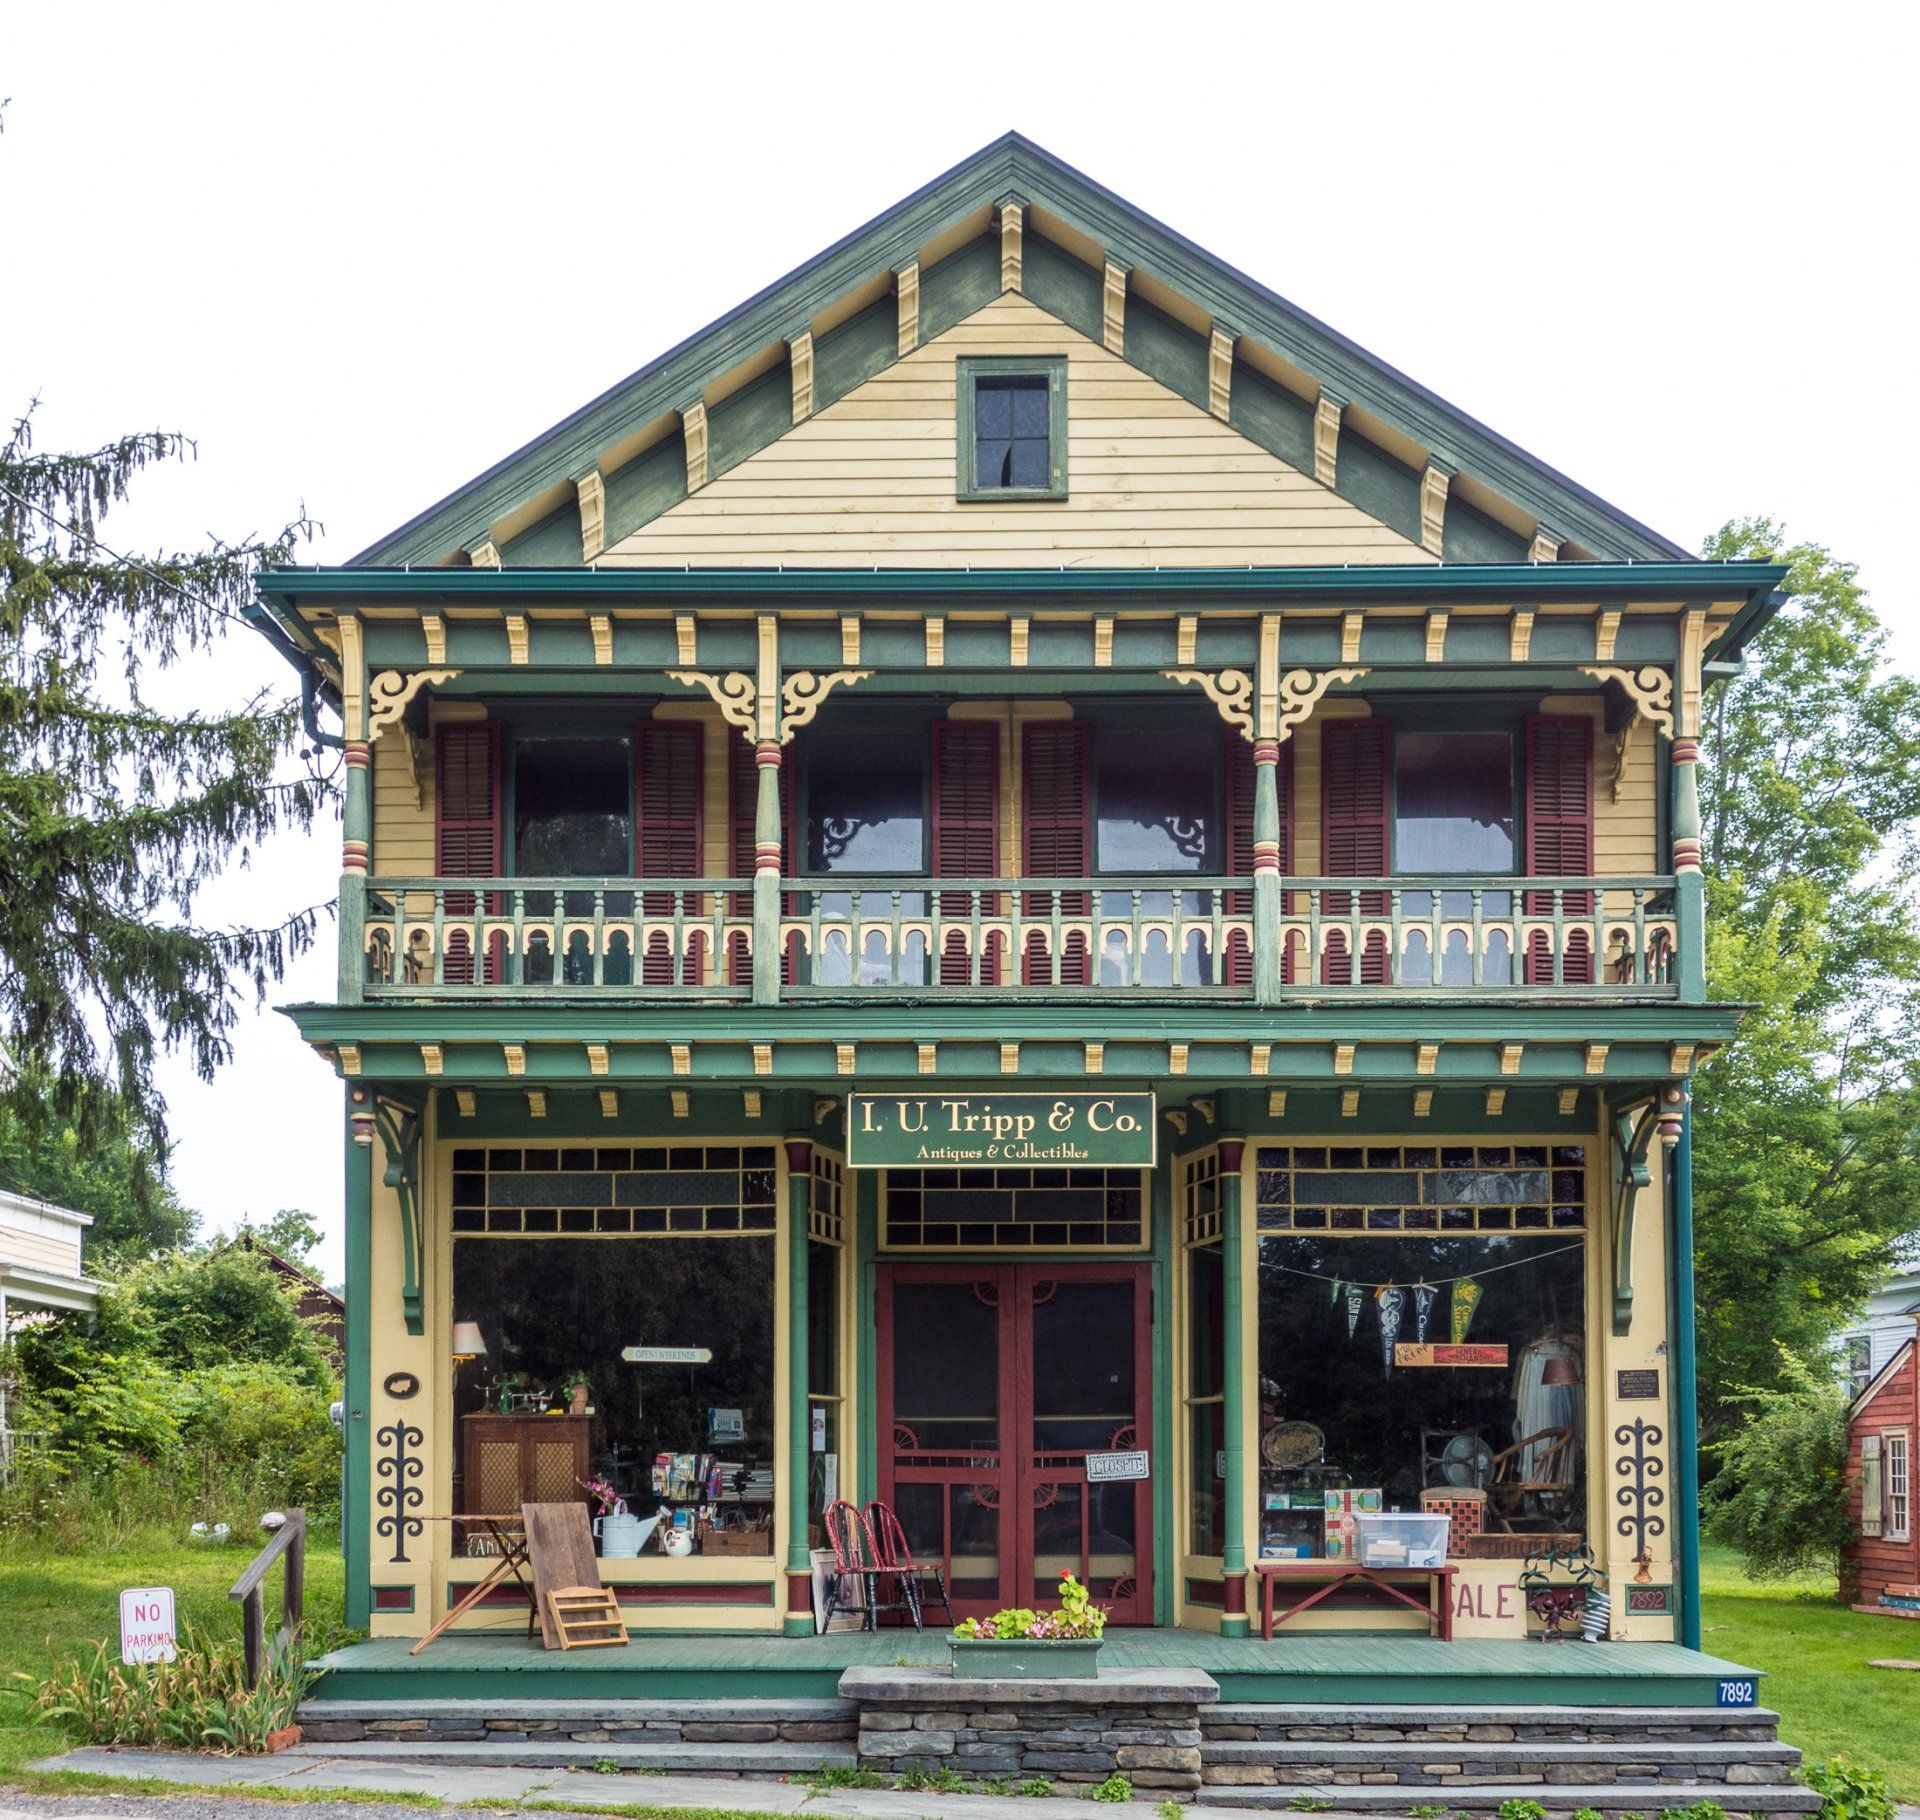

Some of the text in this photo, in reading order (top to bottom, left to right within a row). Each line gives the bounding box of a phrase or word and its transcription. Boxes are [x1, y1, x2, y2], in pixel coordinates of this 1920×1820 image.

[861, 1100, 1142, 1140] I. U. Tripp & Co.
[916, 1143, 1088, 1162] Antiques & Collectibles
[1348, 1297, 1361, 1315] SAN
[1385, 1337, 1393, 1348] LOS
[635, 1350, 696, 1360] OPEN WEEKENDS
[1095, 1459, 1139, 1474] CLOSED
[1630, 1590, 1665, 1609] 7892
[135, 1603, 160, 1622] NO
[1720, 1682, 1752, 1703] 7892
